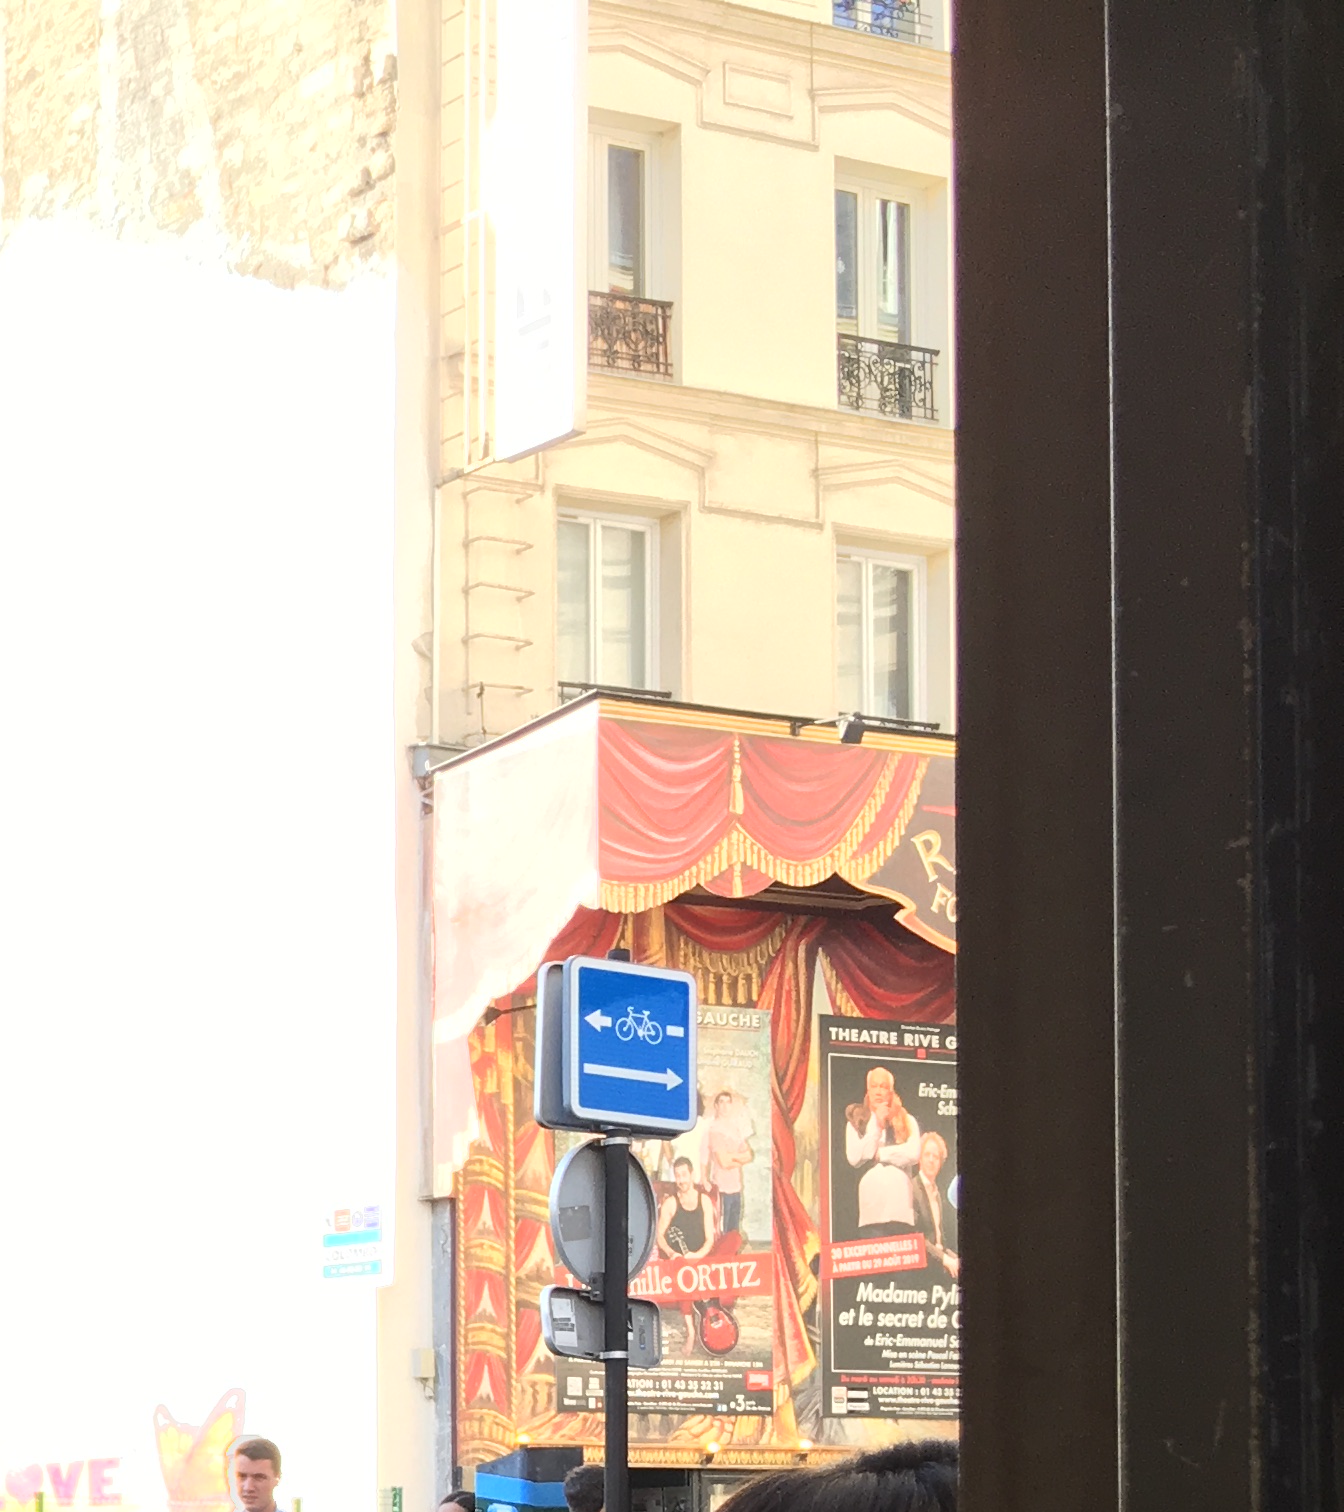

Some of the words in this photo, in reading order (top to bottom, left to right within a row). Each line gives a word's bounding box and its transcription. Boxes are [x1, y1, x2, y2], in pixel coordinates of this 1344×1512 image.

[829, 1026, 898, 1045] THEATRE
[903, 1032, 940, 1049] RIVE
[677, 1261, 760, 1293] ORTIZ
[856, 1281, 928, 1304] Madame
[838, 1308, 856, 1326] et
[858, 1304, 873, 1326] le
[877, 1310, 924, 1328] secret
[926, 1306, 947, 1329] de
[661, 1379, 671, 1389] 01
[674, 1380, 686, 1389] 43
[873, 1386, 913, 1395] LOCATION
